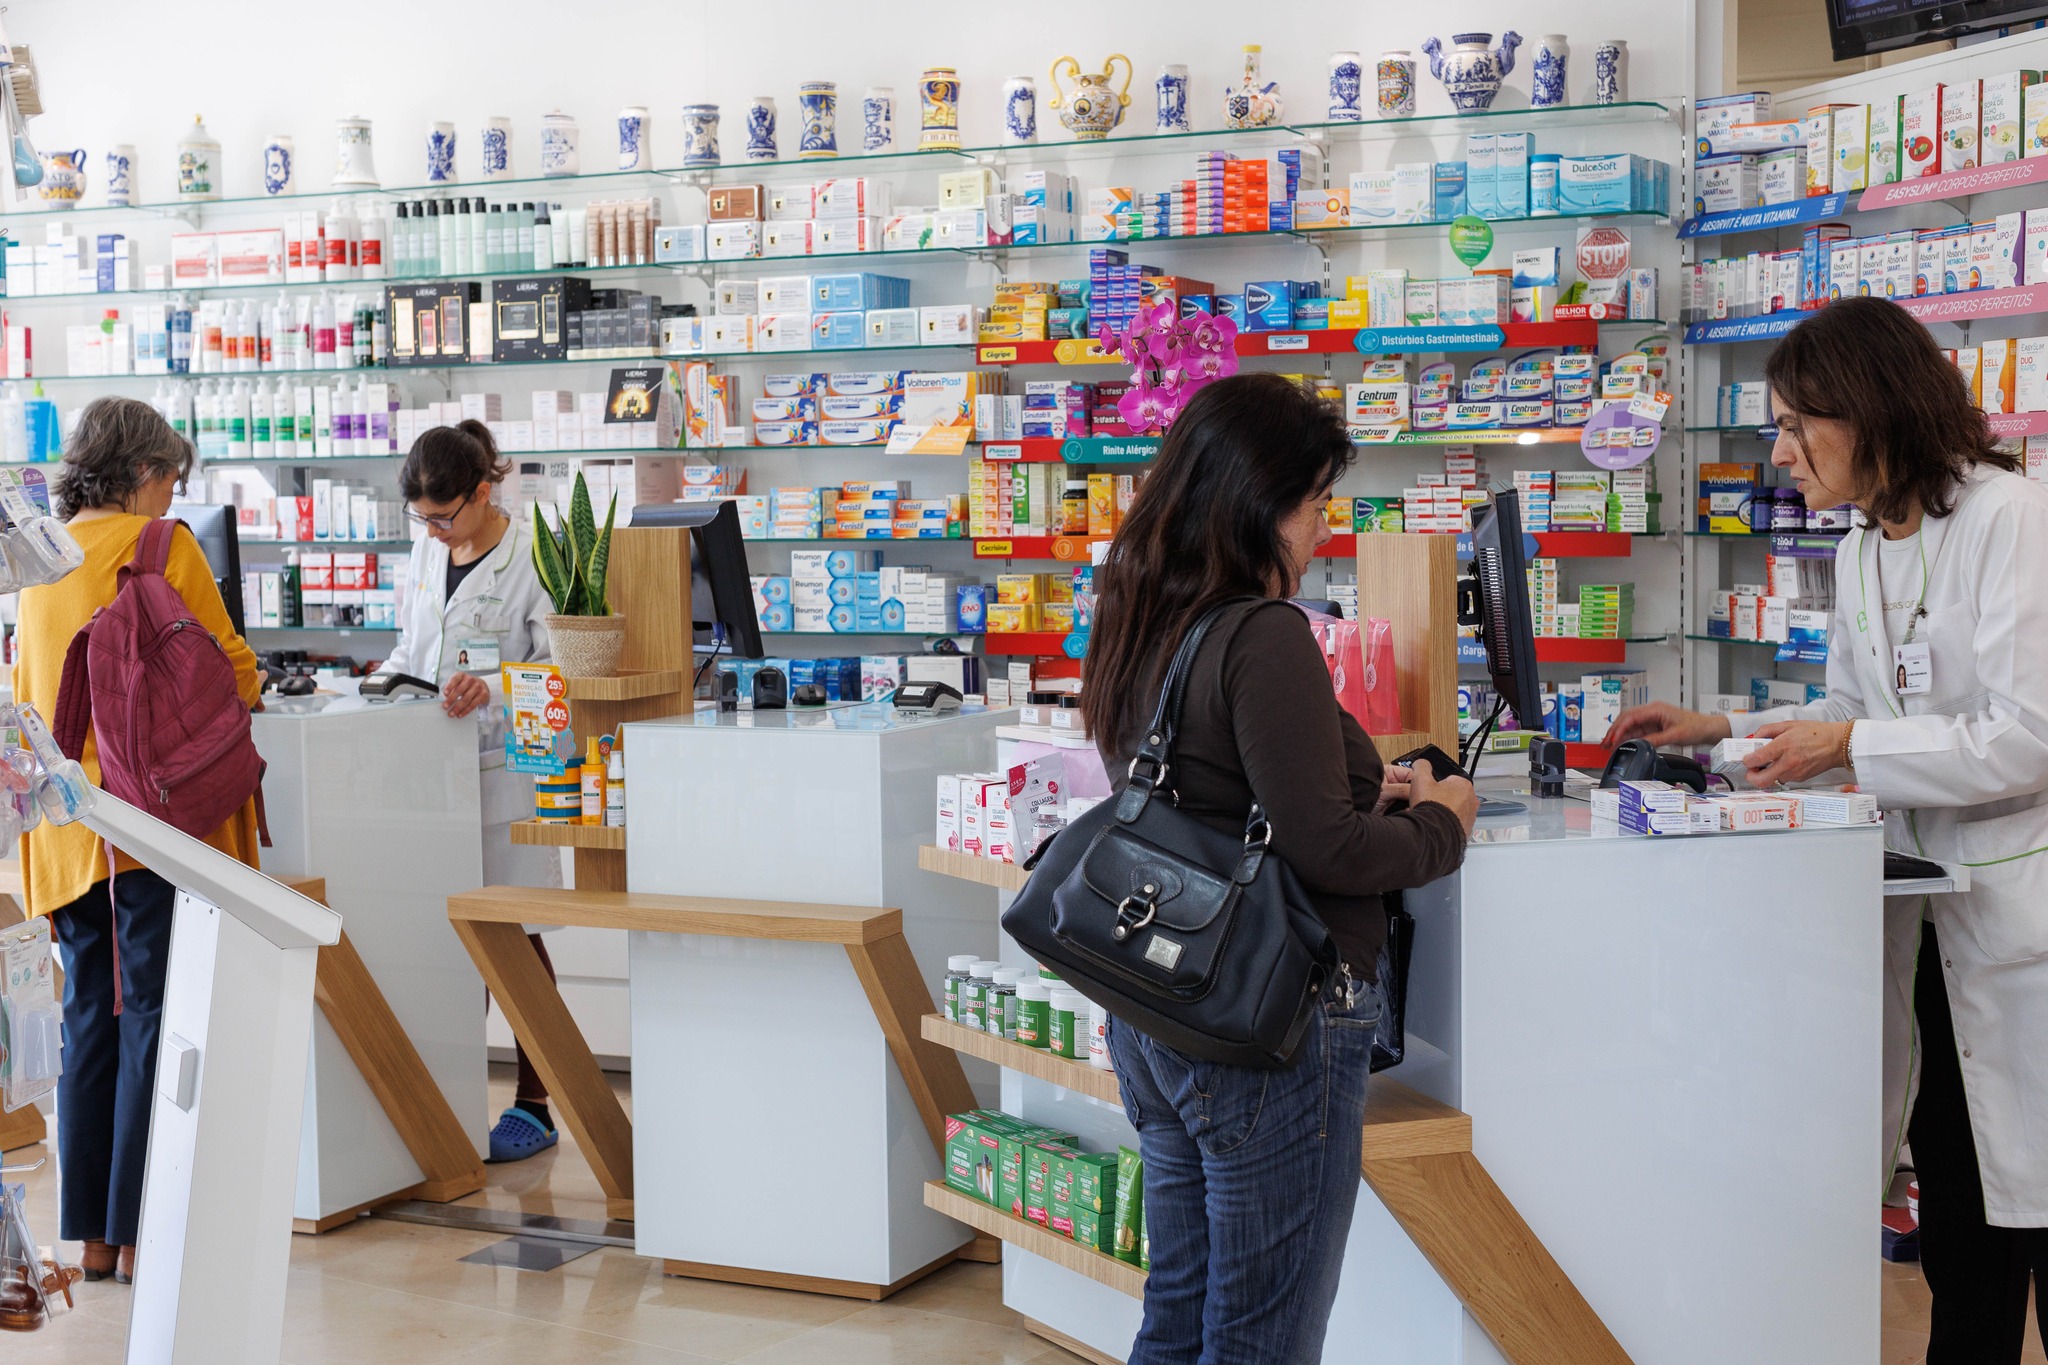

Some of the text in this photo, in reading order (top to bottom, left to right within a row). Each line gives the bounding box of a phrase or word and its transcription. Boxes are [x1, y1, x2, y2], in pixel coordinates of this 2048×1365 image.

[1996, 99, 2003, 107] DE
[1944, 110, 1954, 118] SOPA
[1984, 107, 1996, 116] ALHO
[1944, 112, 1972, 124] COGUMELOS
[1984, 112, 2005, 123] FRANCÊS
[1905, 122, 1921, 130] TOMATE
[1572, 162, 1617, 173] DulcoSoft
[1766, 171, 1785, 179] Absorvit
[1353, 180, 1391, 190] ATYFLOR
[1706, 178, 1729, 186] Absorvit
[1765, 181, 1778, 189] SMART
[1885, 164, 2034, 200] EASYSLIM® CORPOS PERFEITOS
[1699, 207, 1799, 232] ABSORVIT É MUITA VITAMINA!
[2028, 226, 2048, 235] BLOCKE
[1997, 232, 2008, 240] LIPO
[1946, 249, 1966, 258] Absorvit
[1973, 244, 1993, 254] Absorvit
[1581, 246, 1624, 266] STOP
[1887, 254, 1908, 264] Absorvit
[1920, 252, 1939, 261] Absorvit
[1833, 262, 1853, 270] Absorvit
[1863, 260, 1883, 269] Absorvit
[1887, 264, 1901, 272] SMART
[516, 283, 538, 291] LIERAC
[1061, 282, 1079, 290] ilvico
[416, 288, 437, 297] LIERAC
[1938, 293, 2034, 315] CORPOS PERFEITOS
[1050, 310, 1070, 320] ilvico
[1555, 307, 1586, 315] MELHOR
[1707, 322, 1768, 338] ABSORVIT É MUITA
[1382, 332, 1499, 346] Distúrbios Gastrointestinais
[2021, 344, 2044, 352] EASYSLIM
[1984, 359, 1998, 367] CELL
[2021, 357, 2033, 365] DUO
[907, 377, 962, 387] Voltaren Plast
[1511, 378, 1541, 386] Centrum
[1608, 376, 1634, 384] Centrum
[1358, 391, 1398, 400] Centrum
[1457, 405, 1491, 413] Centrum
[1511, 405, 1541, 413] Centrum
[1563, 407, 1587, 415] Centrum
[1350, 428, 1389, 436] Centrum
[1103, 445, 1124, 455] Rinite
[1708, 476, 1747, 485] Vividorm
[846, 484, 870, 493] Fenistil
[1013, 478, 1027, 496] B
[838, 503, 862, 511] Fenistil
[900, 502, 922, 511] Fenistil
[840, 522, 864, 530] Fenistil
[895, 521, 918, 530] Fenistil
[1457, 542, 1465, 551] de
[961, 604, 980, 613] ENO
[1791, 612, 1811, 621] Dextazin
[548, 680, 563, 689] 25%
[547, 708, 567, 720] 60%
[1031, 796, 1053, 806] COLLAGEN
[1744, 809, 1762, 824] 100
[1764, 813, 1784, 821] Actidox
